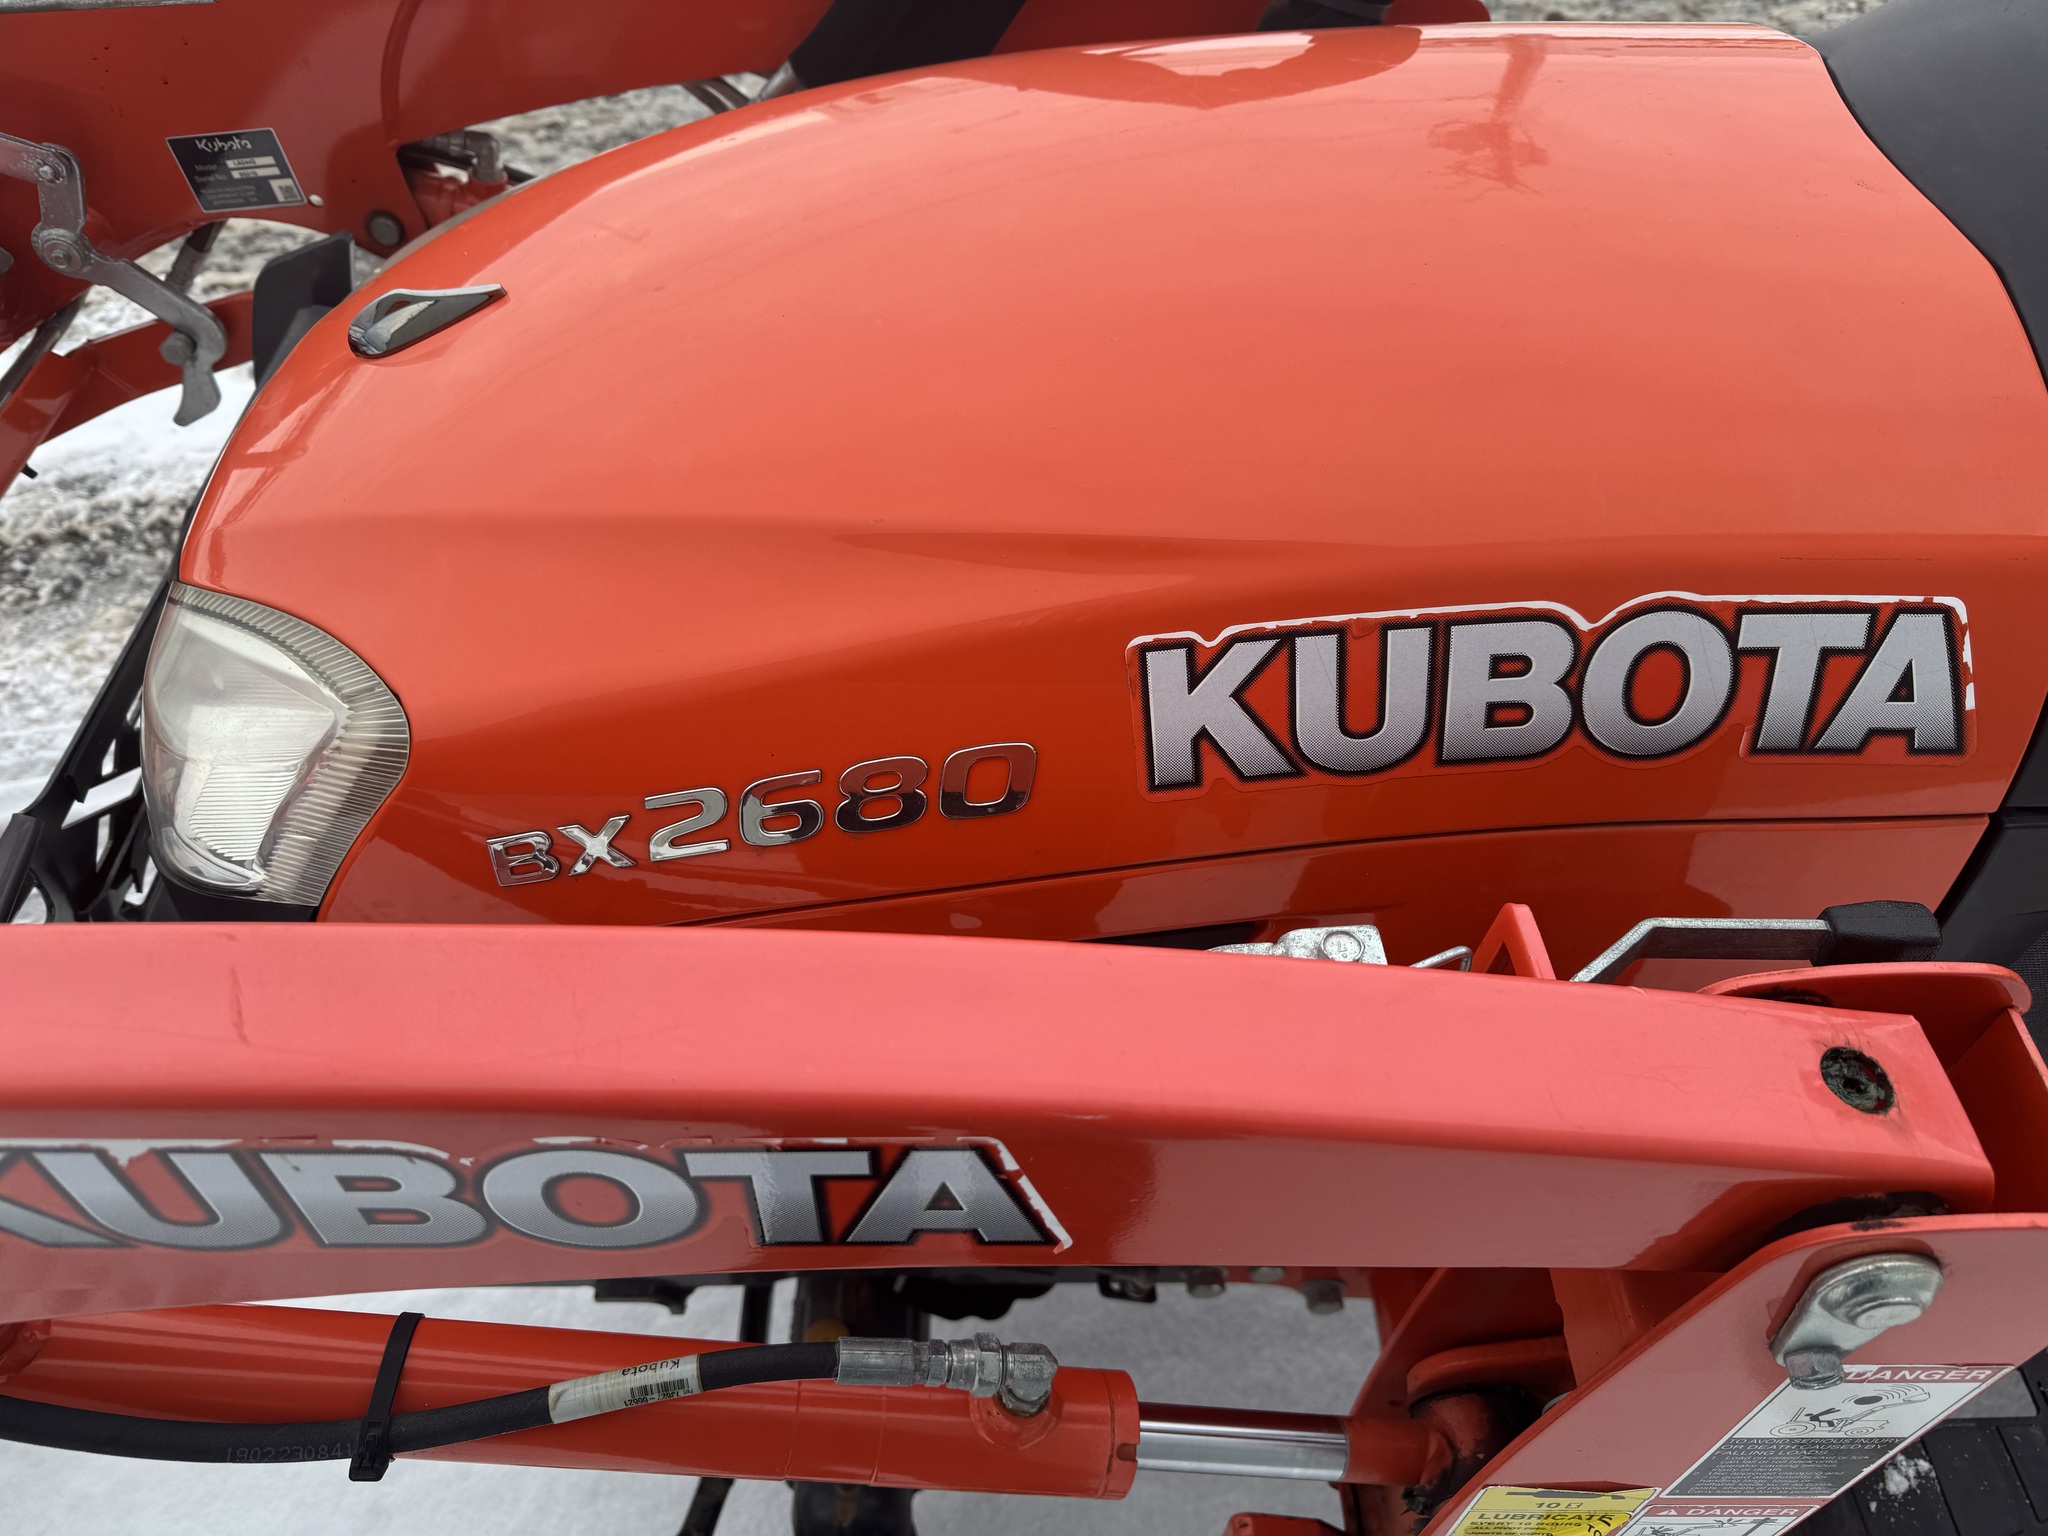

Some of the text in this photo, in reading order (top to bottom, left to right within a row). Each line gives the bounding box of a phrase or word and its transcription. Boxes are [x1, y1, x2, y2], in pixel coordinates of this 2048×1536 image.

[195, 136, 252, 153] Kubota
[1143, 605, 1962, 789] KUBOTA
[486, 741, 1037, 887] BX2680
[622, 1359, 680, 1376] Kubota
[1846, 1370, 1992, 1380] DANGER
[1477, 1513, 1614, 1521] LUBRICATE
[1686, 1508, 1800, 1516] DANGER
